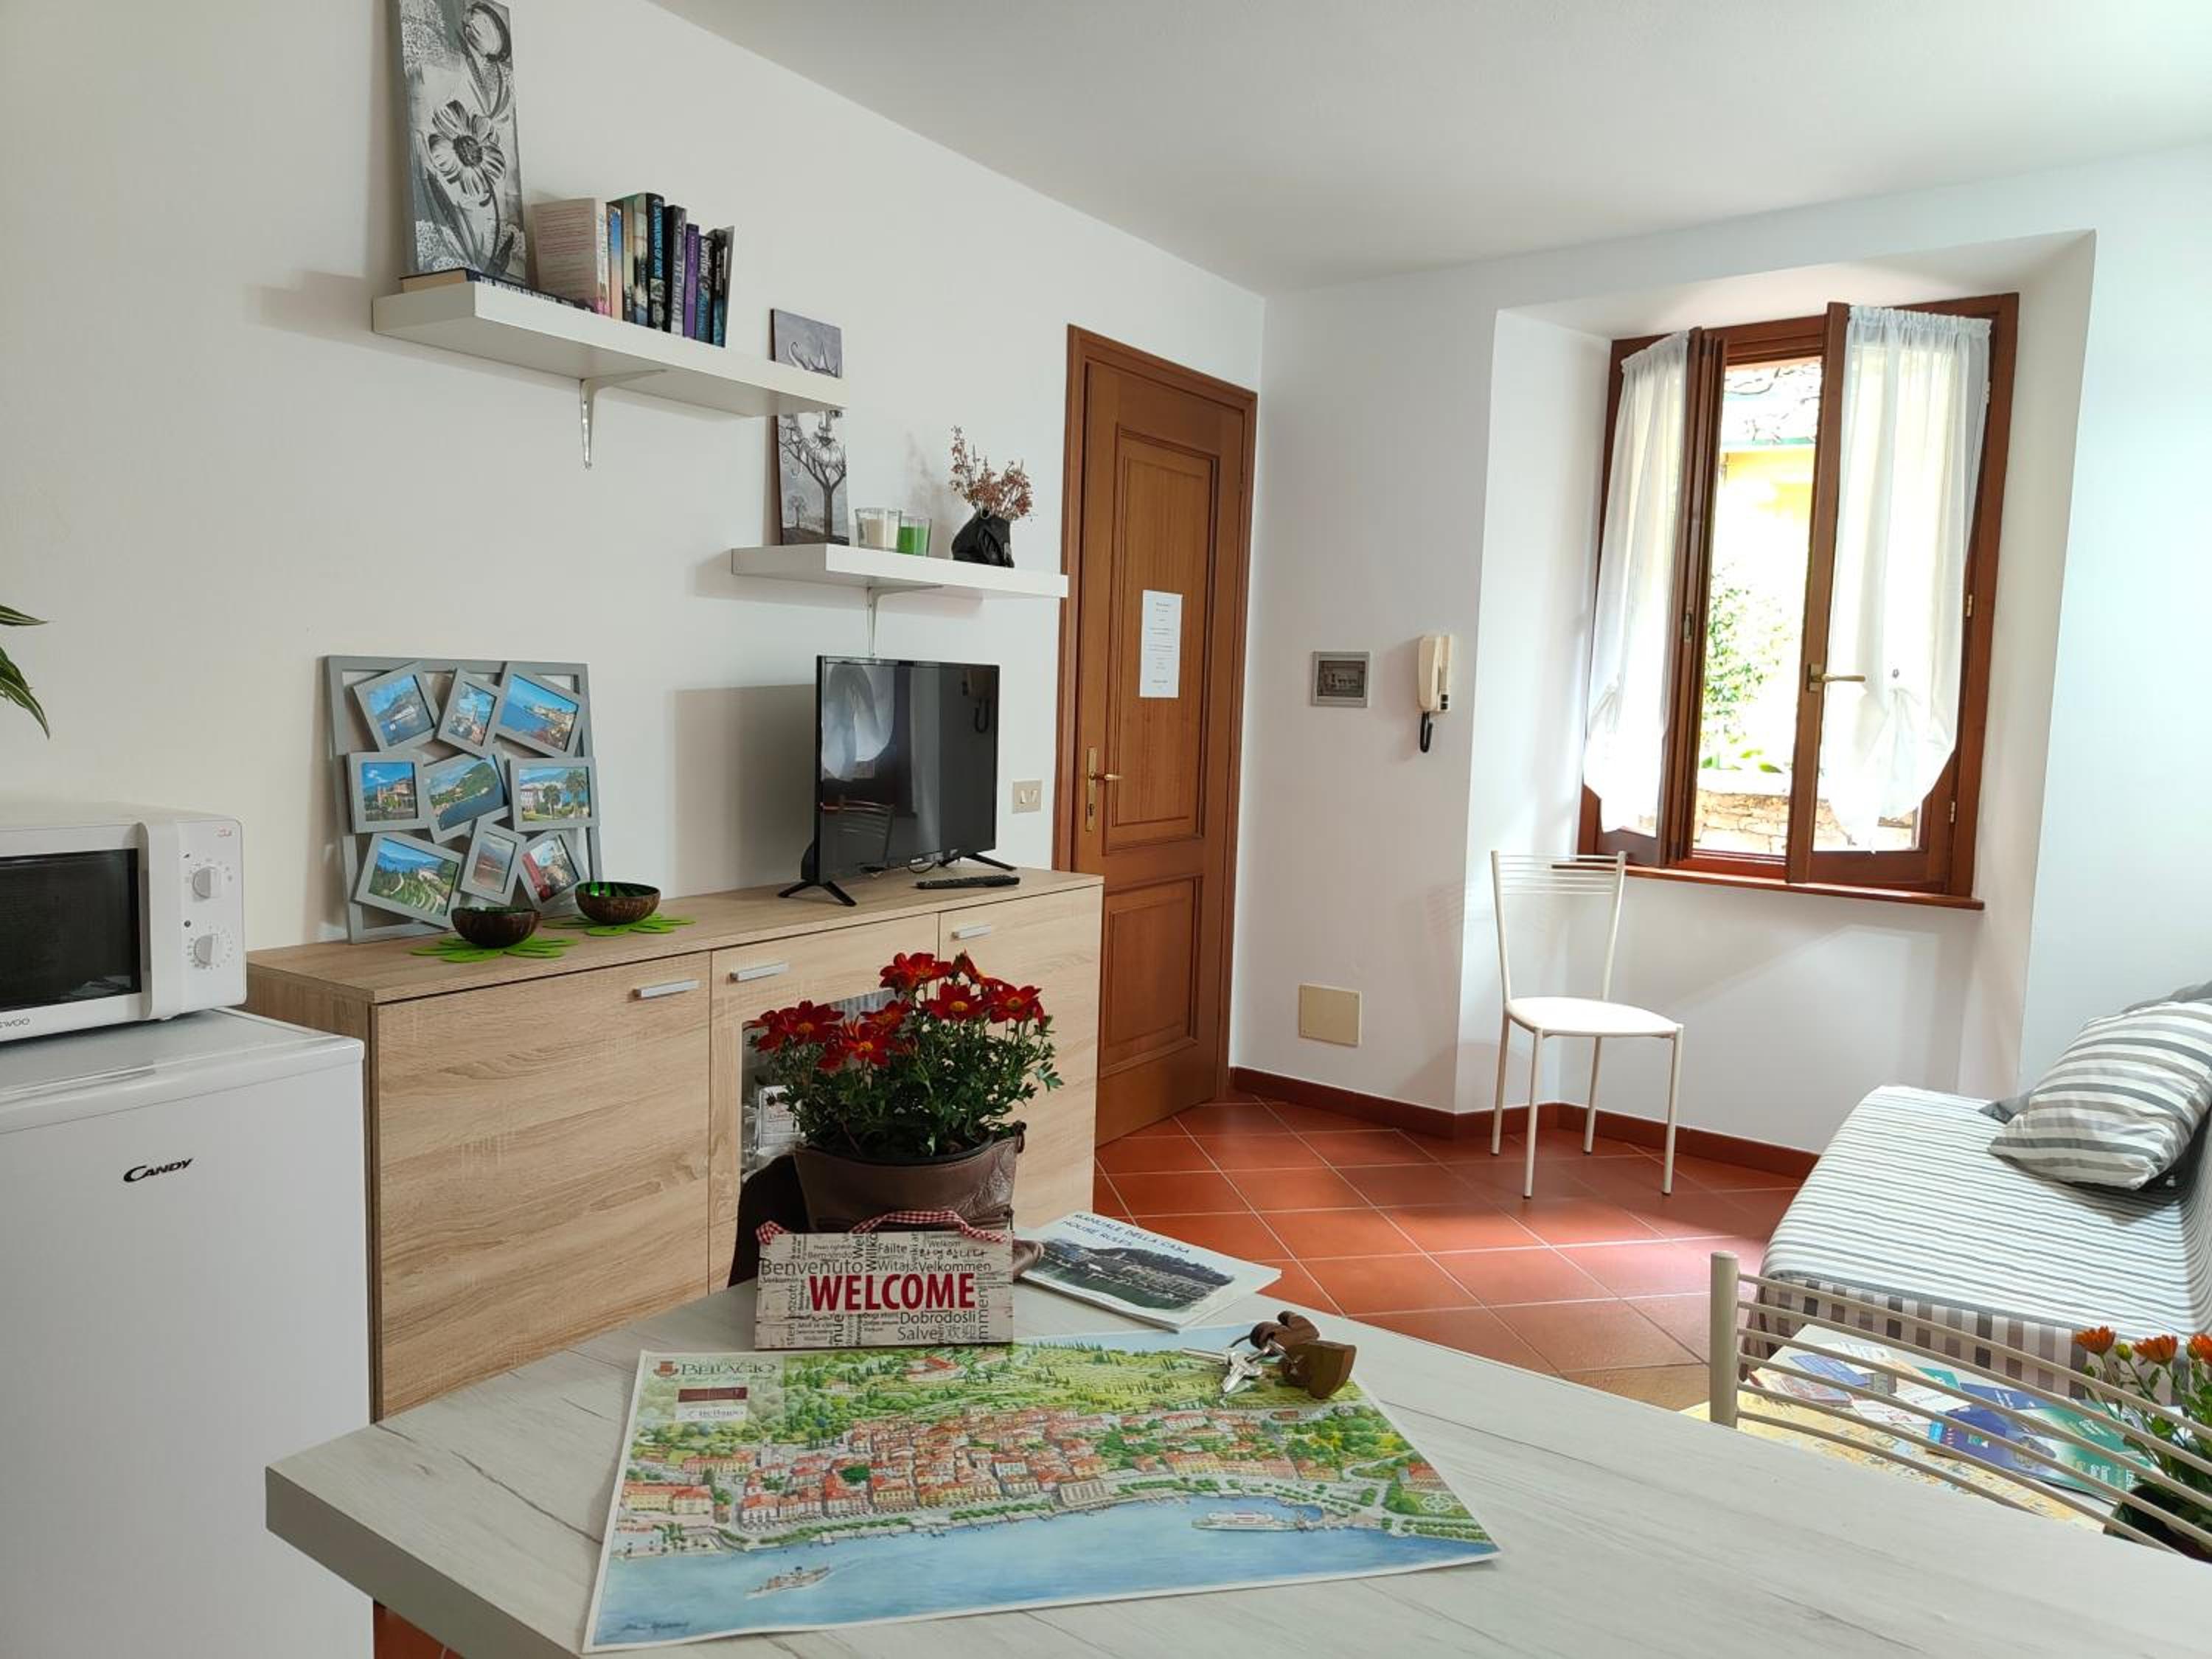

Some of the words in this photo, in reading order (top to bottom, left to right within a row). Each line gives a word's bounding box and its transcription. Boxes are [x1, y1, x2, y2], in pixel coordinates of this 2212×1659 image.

[760, 1259, 863, 1275] Benvenuto
[919, 1262, 992, 1273] Velkommen
[810, 1273, 975, 1311] WELCOME
[897, 1325, 938, 1341] Salve
